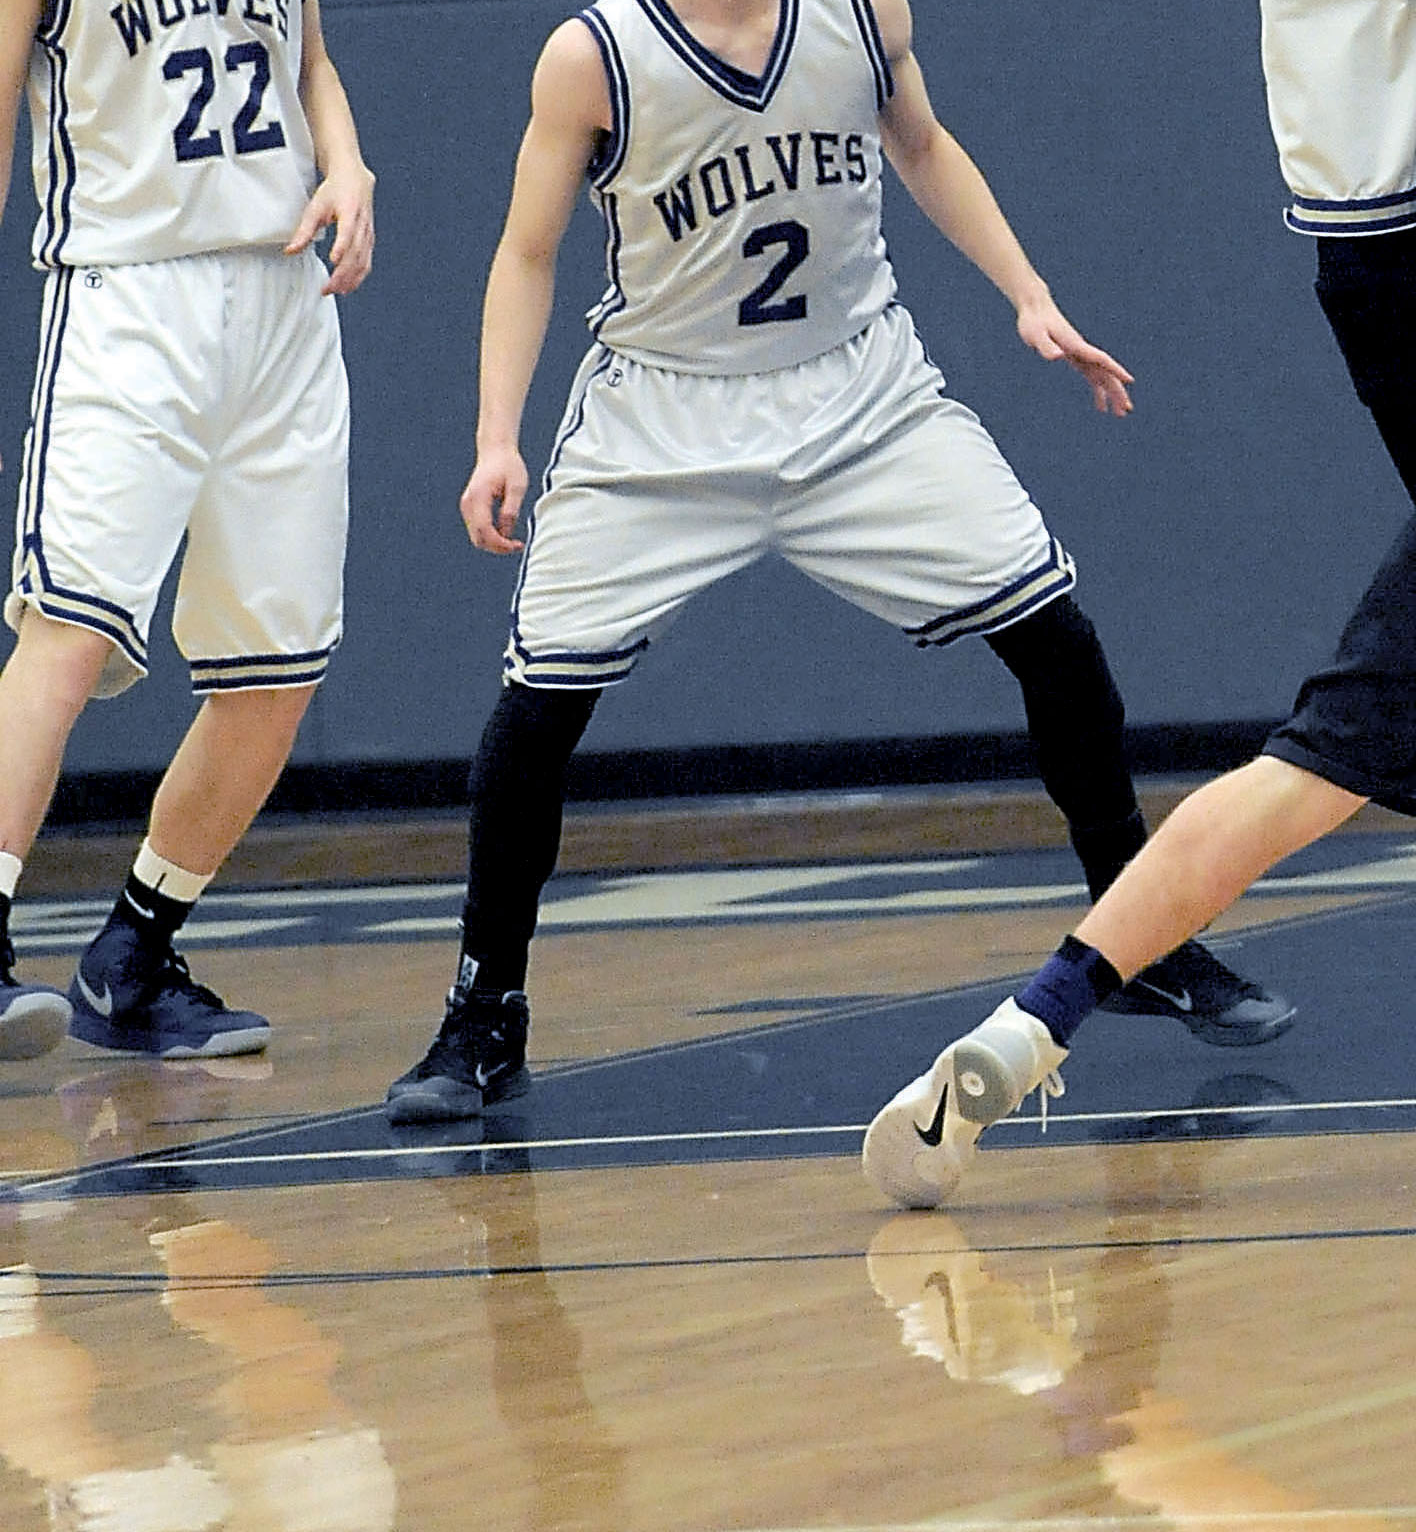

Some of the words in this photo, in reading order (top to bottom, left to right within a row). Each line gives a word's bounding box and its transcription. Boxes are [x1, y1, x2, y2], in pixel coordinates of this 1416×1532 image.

[162, 40, 287, 163] 22
[652, 131, 868, 243] WOLVES
[737, 219, 810, 327] 2
